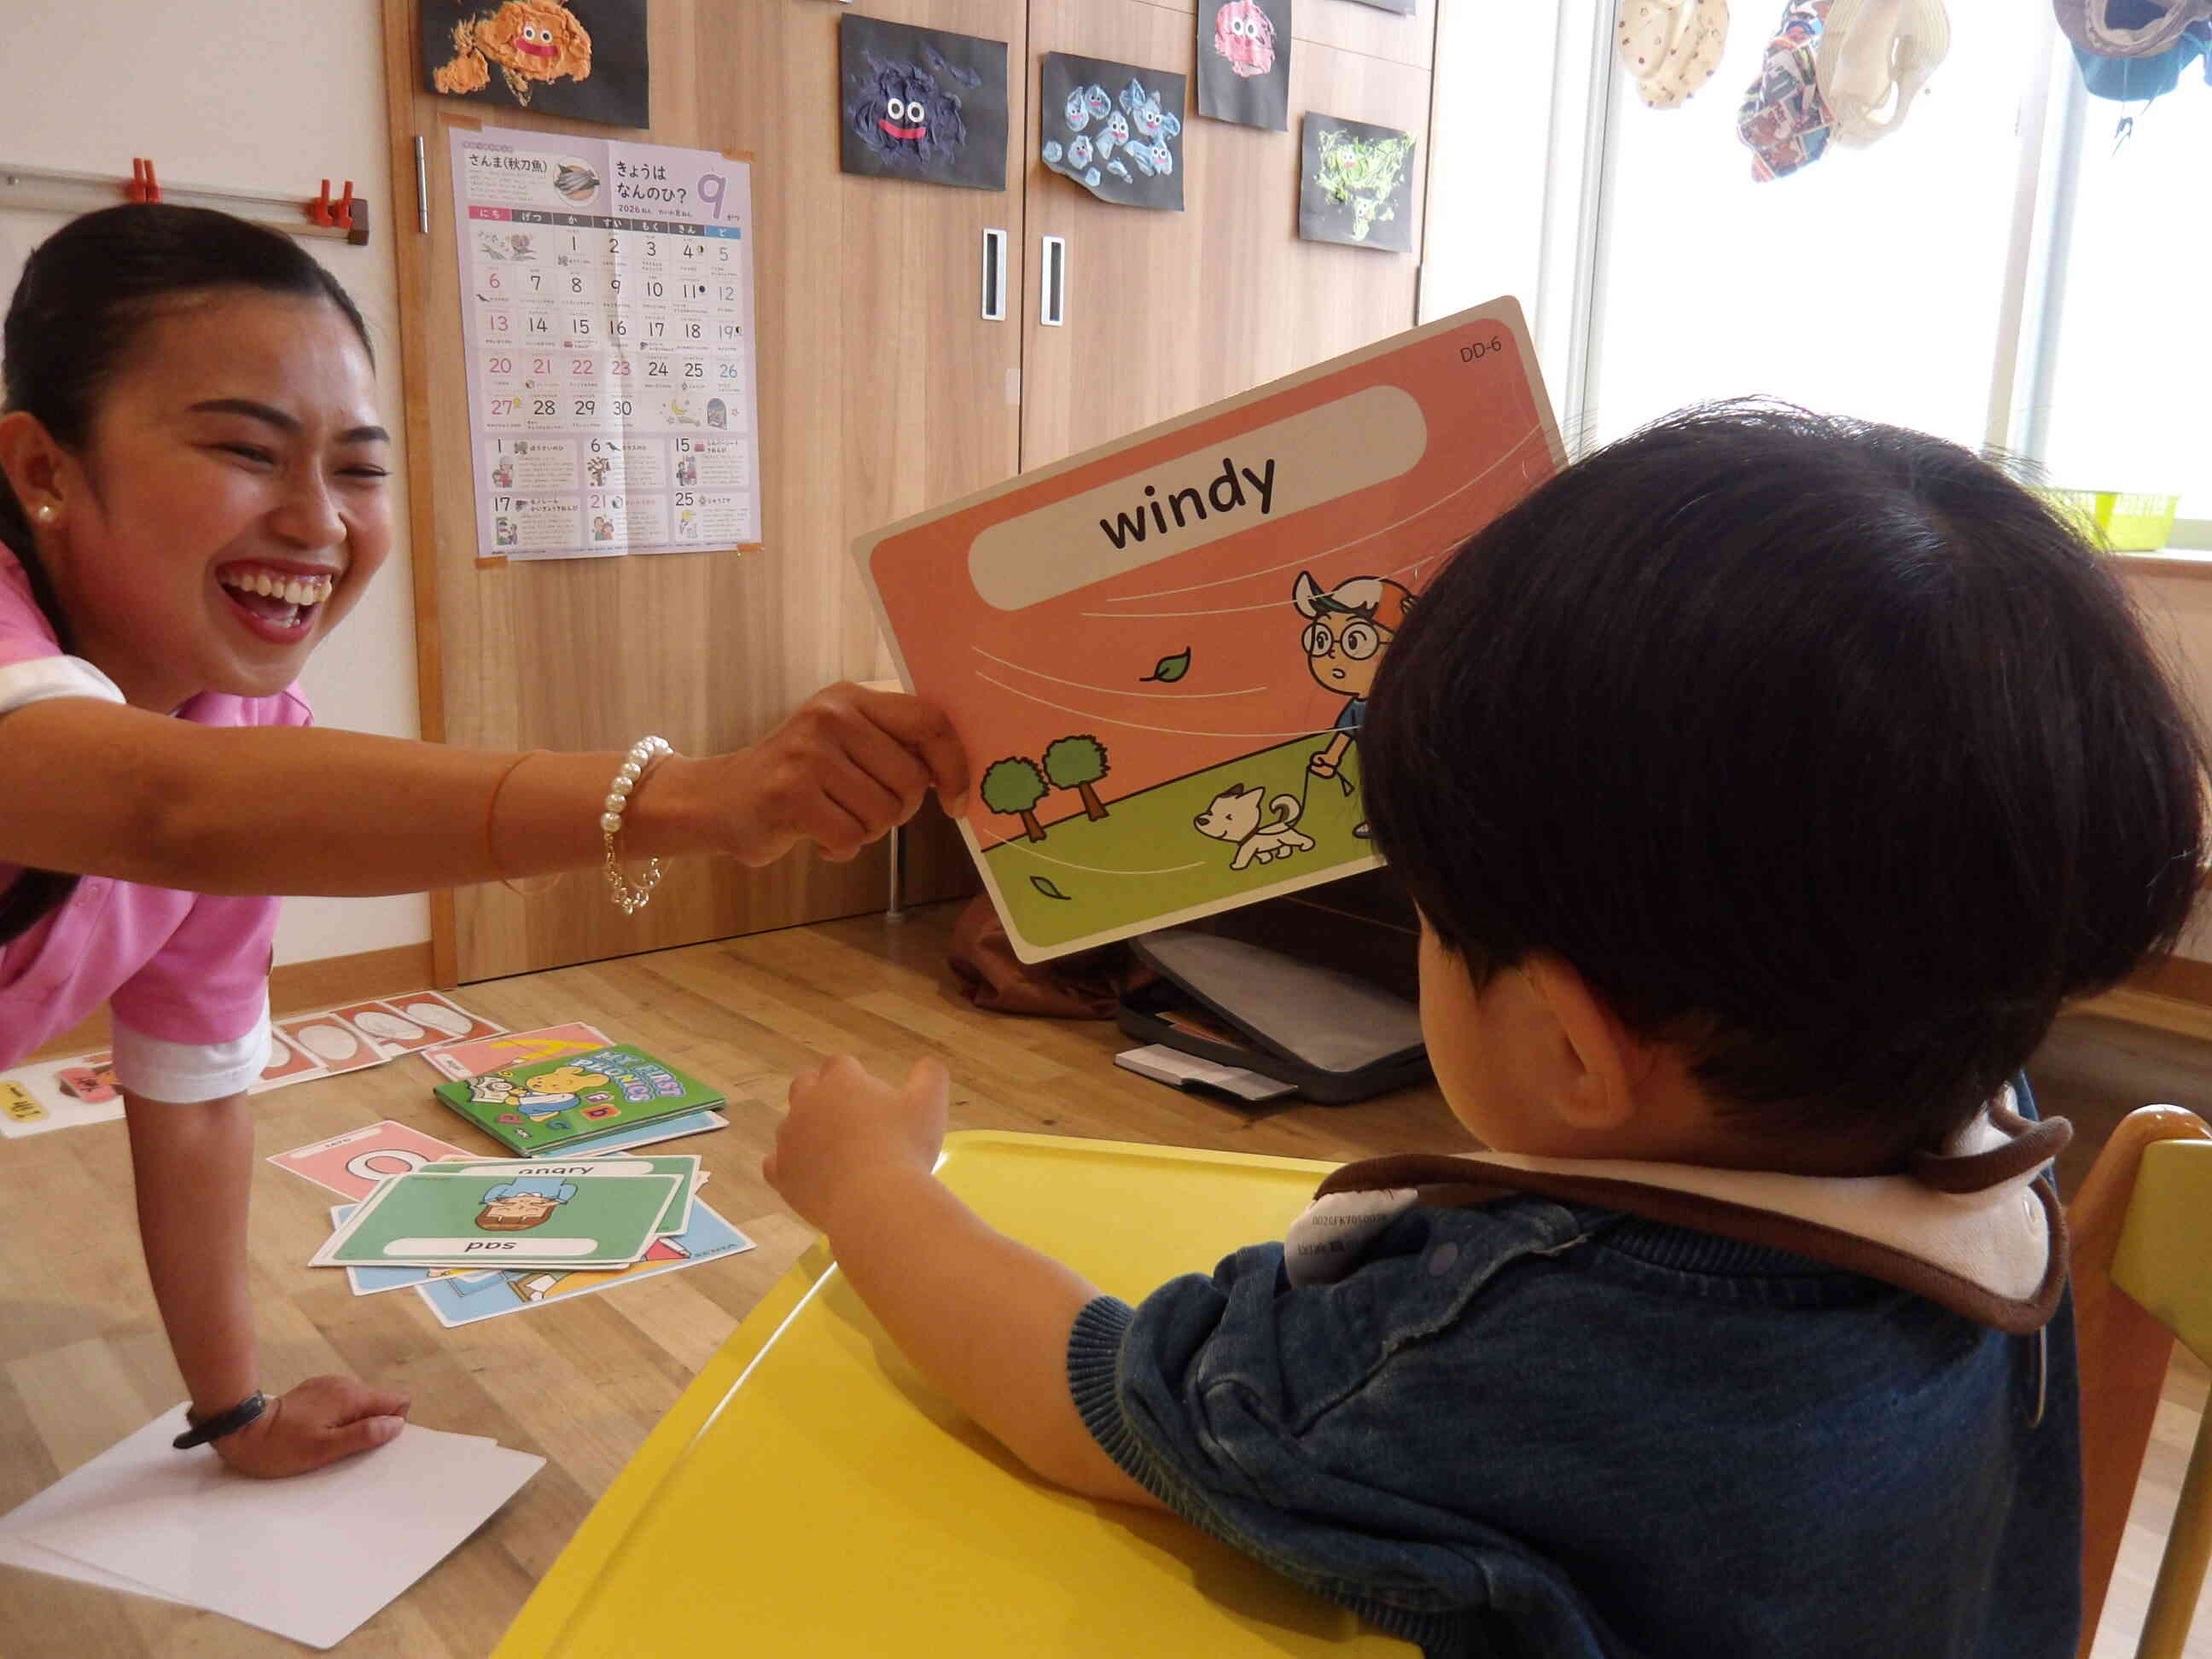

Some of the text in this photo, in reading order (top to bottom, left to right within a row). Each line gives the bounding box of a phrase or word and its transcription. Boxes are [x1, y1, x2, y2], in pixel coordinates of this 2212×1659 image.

[616, 160, 667, 180] きょうは
[616, 182, 687, 204] なんのひ?
[479, 208, 727, 237] にち げつ か すい もく きん ど
[608, 238, 620, 253] 2
[647, 241, 656, 256] 3
[683, 245, 694, 259] 4
[719, 247, 729, 261] 5
[489, 273, 735, 301] 6 7 8 9 10 11 12
[491, 315, 734, 340] 13 14 15 16 17 18 19
[1460, 335, 1502, 363] DD-6
[489, 358, 738, 378] 20 21 22 23 24 25 26
[491, 399, 632, 416] 27 28 29 30
[591, 438, 601, 452] 6
[675, 438, 690, 452] 15
[494, 497, 510, 512] 17
[591, 494, 606, 509] 21
[675, 492, 694, 506] 25
[1099, 457, 1275, 549] windy
[464, 1240, 517, 1253] sad
